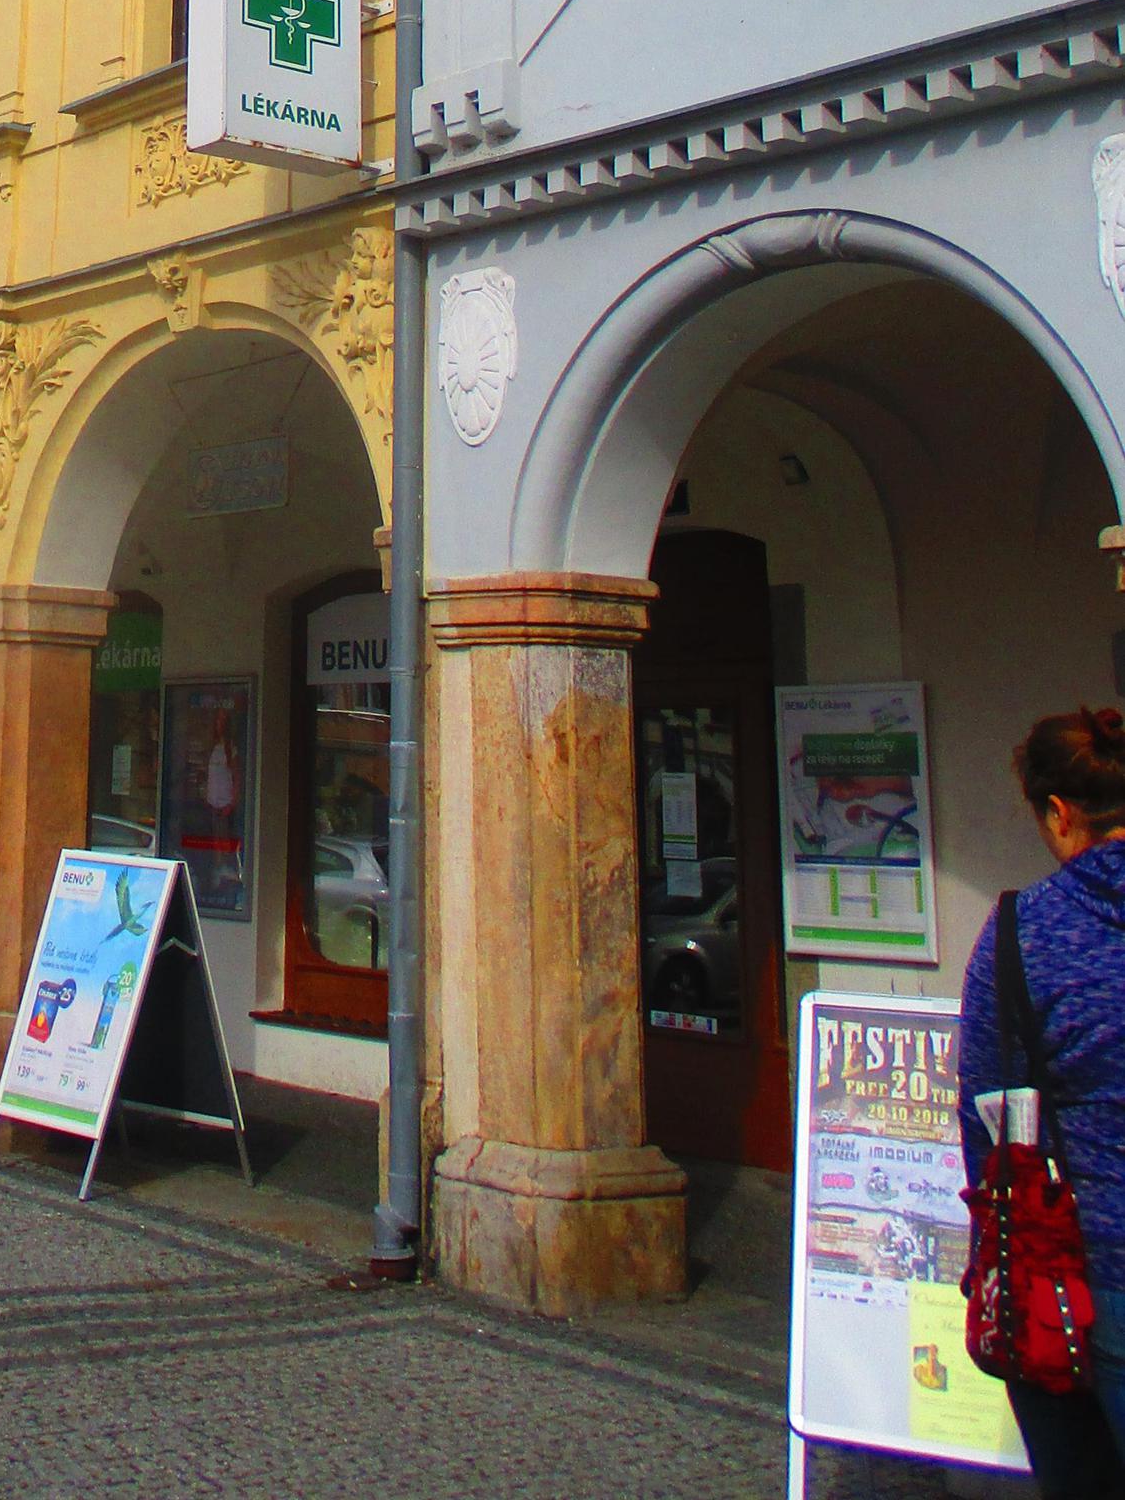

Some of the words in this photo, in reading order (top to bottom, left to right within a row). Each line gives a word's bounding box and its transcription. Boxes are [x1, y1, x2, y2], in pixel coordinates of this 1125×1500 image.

[240, 92, 342, 133] LÉKÁRNA
[95, 640, 163, 670] ékárna
[321, 638, 388, 671] BENU
[63, 872, 85, 885] BENU
[817, 1016, 959, 1090] FESTIV
[17, 1065, 31, 1078] 139
[846, 1079, 889, 1097] FREE
[891, 1070, 929, 1101] 20
[931, 1087, 960, 1105] TIB
[869, 1145, 934, 1165] IMODIUM
